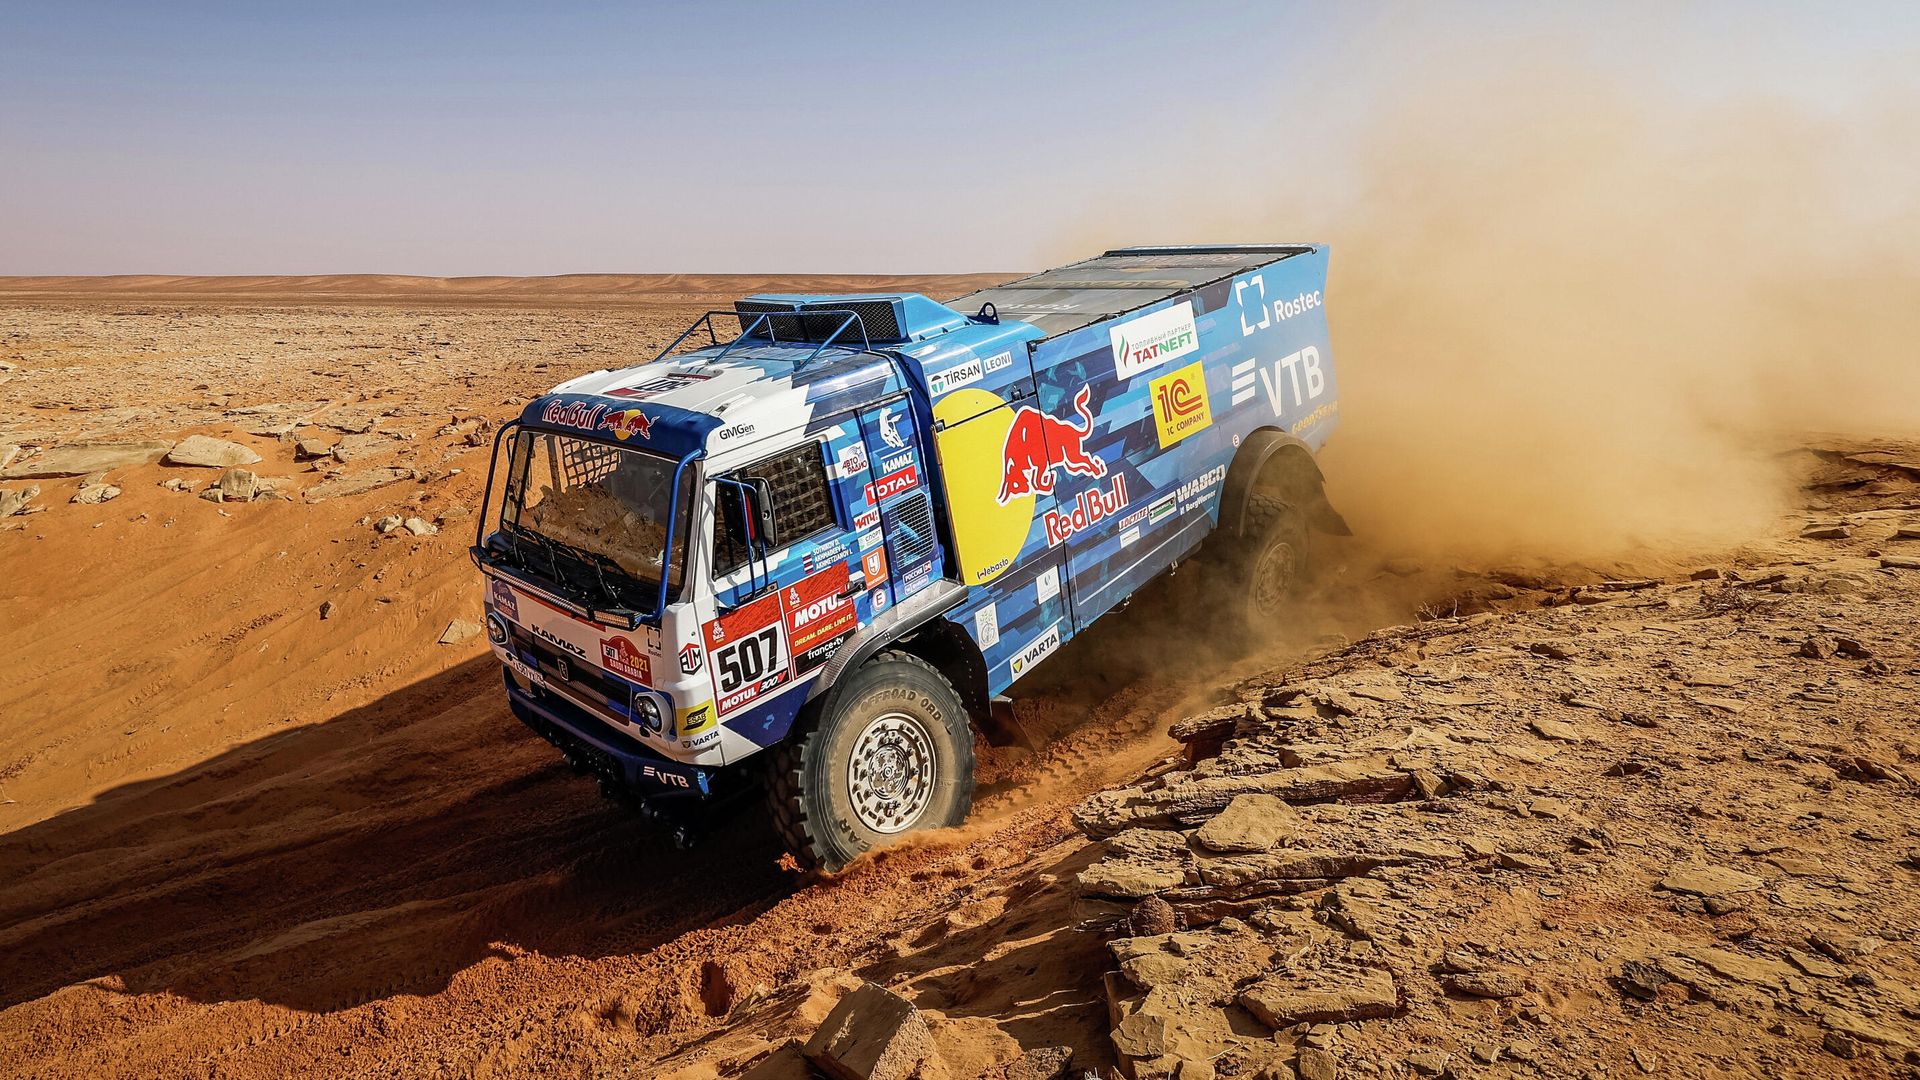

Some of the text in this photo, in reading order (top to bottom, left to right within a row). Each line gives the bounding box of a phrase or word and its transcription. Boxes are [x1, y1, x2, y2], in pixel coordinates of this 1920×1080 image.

[1274, 290, 1322, 322] Rostec
[1133, 331, 1193, 364] TATNEFT
[985, 354, 1010, 371] LEONI
[1259, 345, 1325, 417] VTB
[719, 423, 755, 440] GMGen
[1176, 412, 1205, 431] COMPANY
[881, 451, 914, 474] KAMAZ
[867, 474, 915, 500] TOTAL
[1176, 464, 1226, 503] WABCO
[1120, 508, 1148, 529] LOCTITE
[531, 623, 587, 659] KAMAZ
[1024, 633, 1058, 664] VARTA
[624, 663, 643, 679] ARABIA
[629, 655, 649, 672] 2021
[717, 626, 778, 693] 507
[721, 687, 757, 711] MOTUL
[919, 698, 943, 722] ORD
[692, 731, 720, 747] VARTA
[656, 771, 690, 788] VTB
